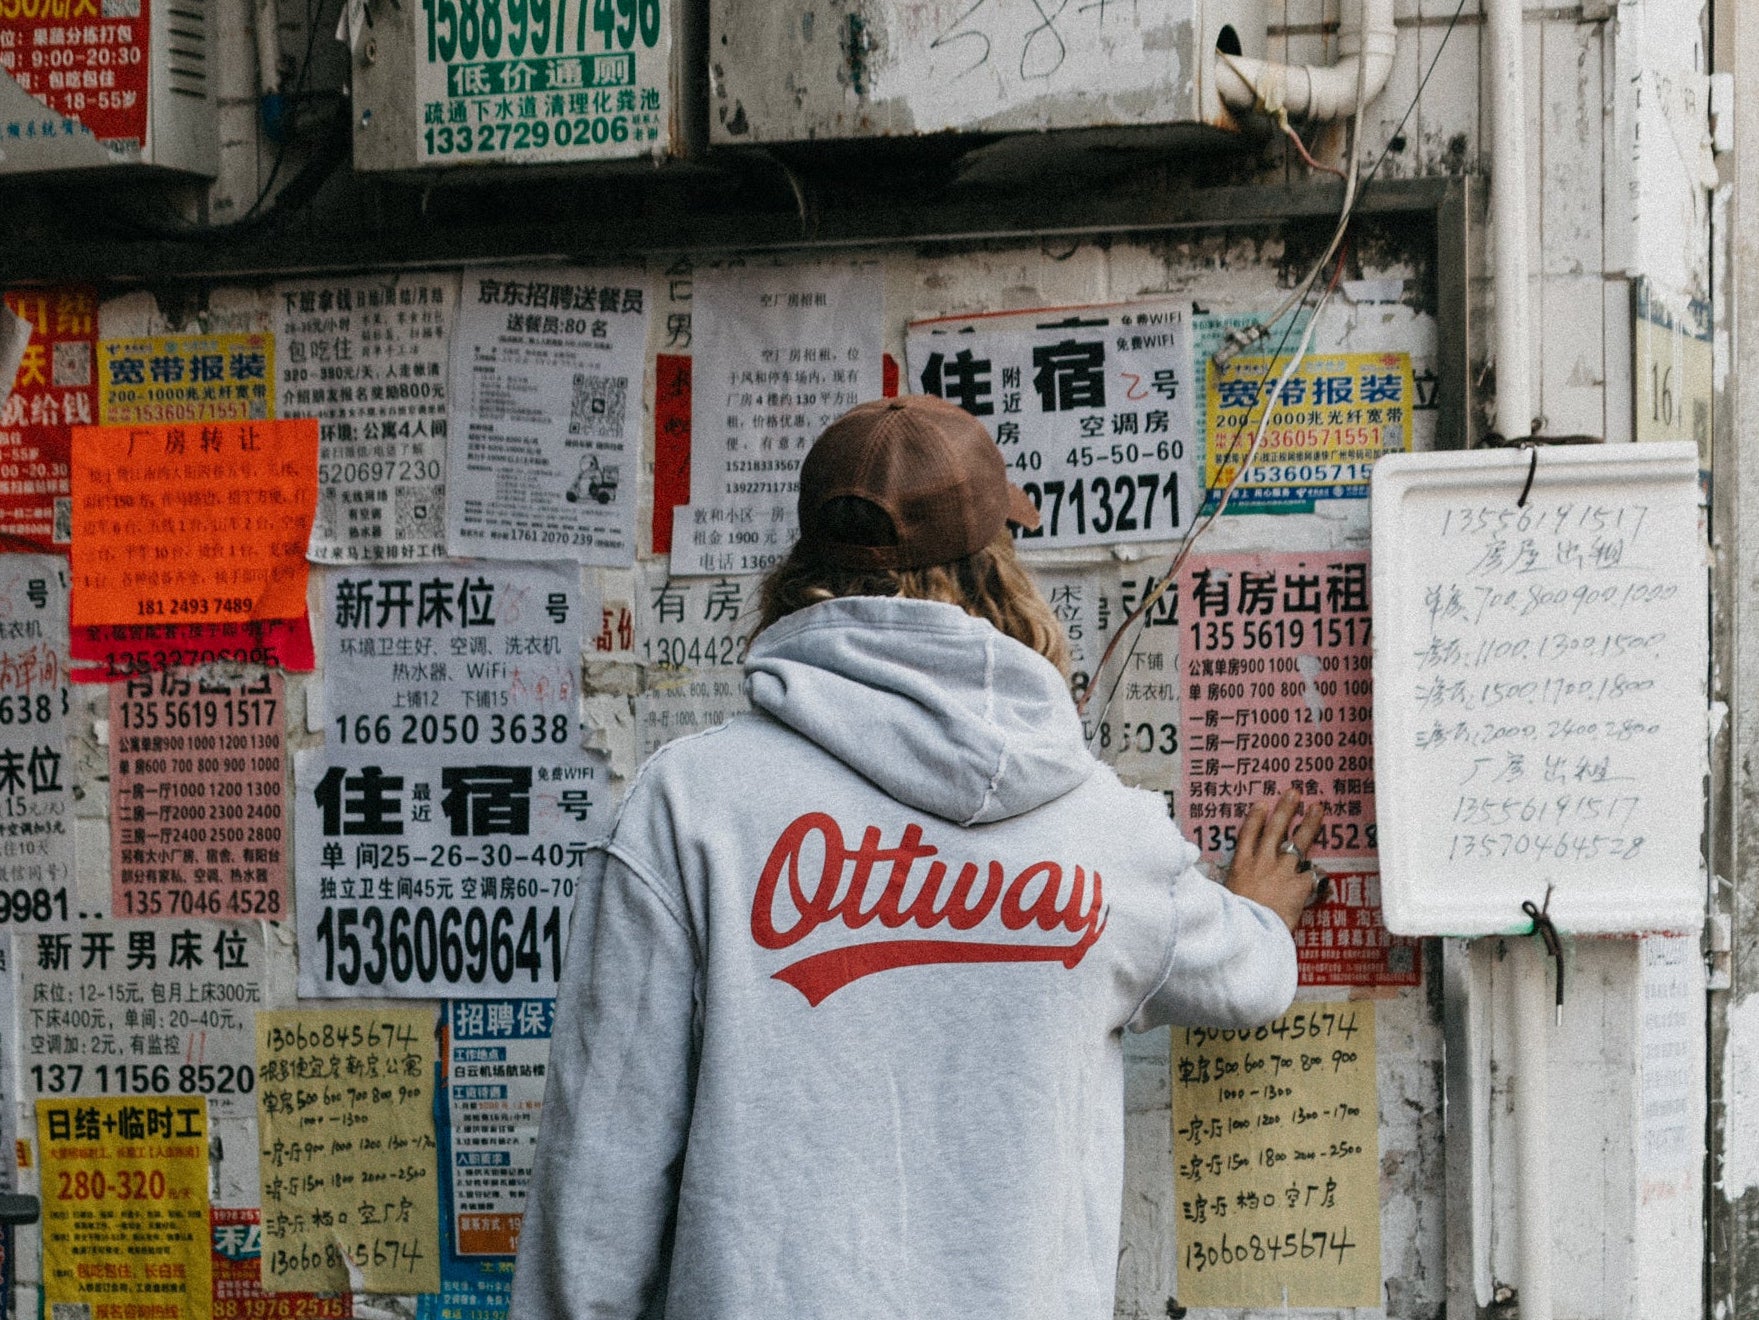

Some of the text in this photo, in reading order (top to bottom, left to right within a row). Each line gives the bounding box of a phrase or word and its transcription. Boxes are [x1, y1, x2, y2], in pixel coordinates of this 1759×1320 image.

[31, 46, 141, 68] 9:00-20:30
[453, 54, 630, 94] 低价通厕
[478, 279, 643, 315] 京东招聘送餐员
[108, 352, 267, 387] 宽带报装
[1033, 339, 1106, 412] 宿
[1217, 374, 1403, 410] 宽带报装
[1080, 409, 1170, 438] 空调房
[1216, 408, 1404, 429] 200-000兆光纤宽带
[127, 425, 262, 457] 厂房转让
[1066, 440, 1183, 467] 45-50-60
[336, 577, 569, 628] 新开床位 号
[1191, 562, 1370, 618] 有房出租
[138, 598, 253, 616] 181 2493 7489
[1190, 616, 1373, 651] 135 5619 1517
[1251, 683, 1275, 698] 700
[120, 699, 277, 729] 135 5619 1517
[336, 713, 568, 745] 166 2050 3638
[1294, 731, 1334, 748] 2300
[1294, 755, 1334, 773] 2500
[314, 766, 404, 836] 住
[441, 765, 533, 837] 宿
[557, 790, 593, 822] 号
[123, 889, 281, 915] 135 7046 4528
[320, 876, 578, 901] 独立卫生间45元 空调房60-70
[751, 811, 1110, 969] Ottway
[37, 928, 250, 971] 新开男床位
[456, 1001, 556, 1037] 招聘保
[31, 1064, 255, 1093] 137 1156 8520
[48, 1105, 203, 1141] 日结+临时工
[58, 1169, 166, 1201] 280-320
[1185, 1225, 1357, 1273] 13060845674
